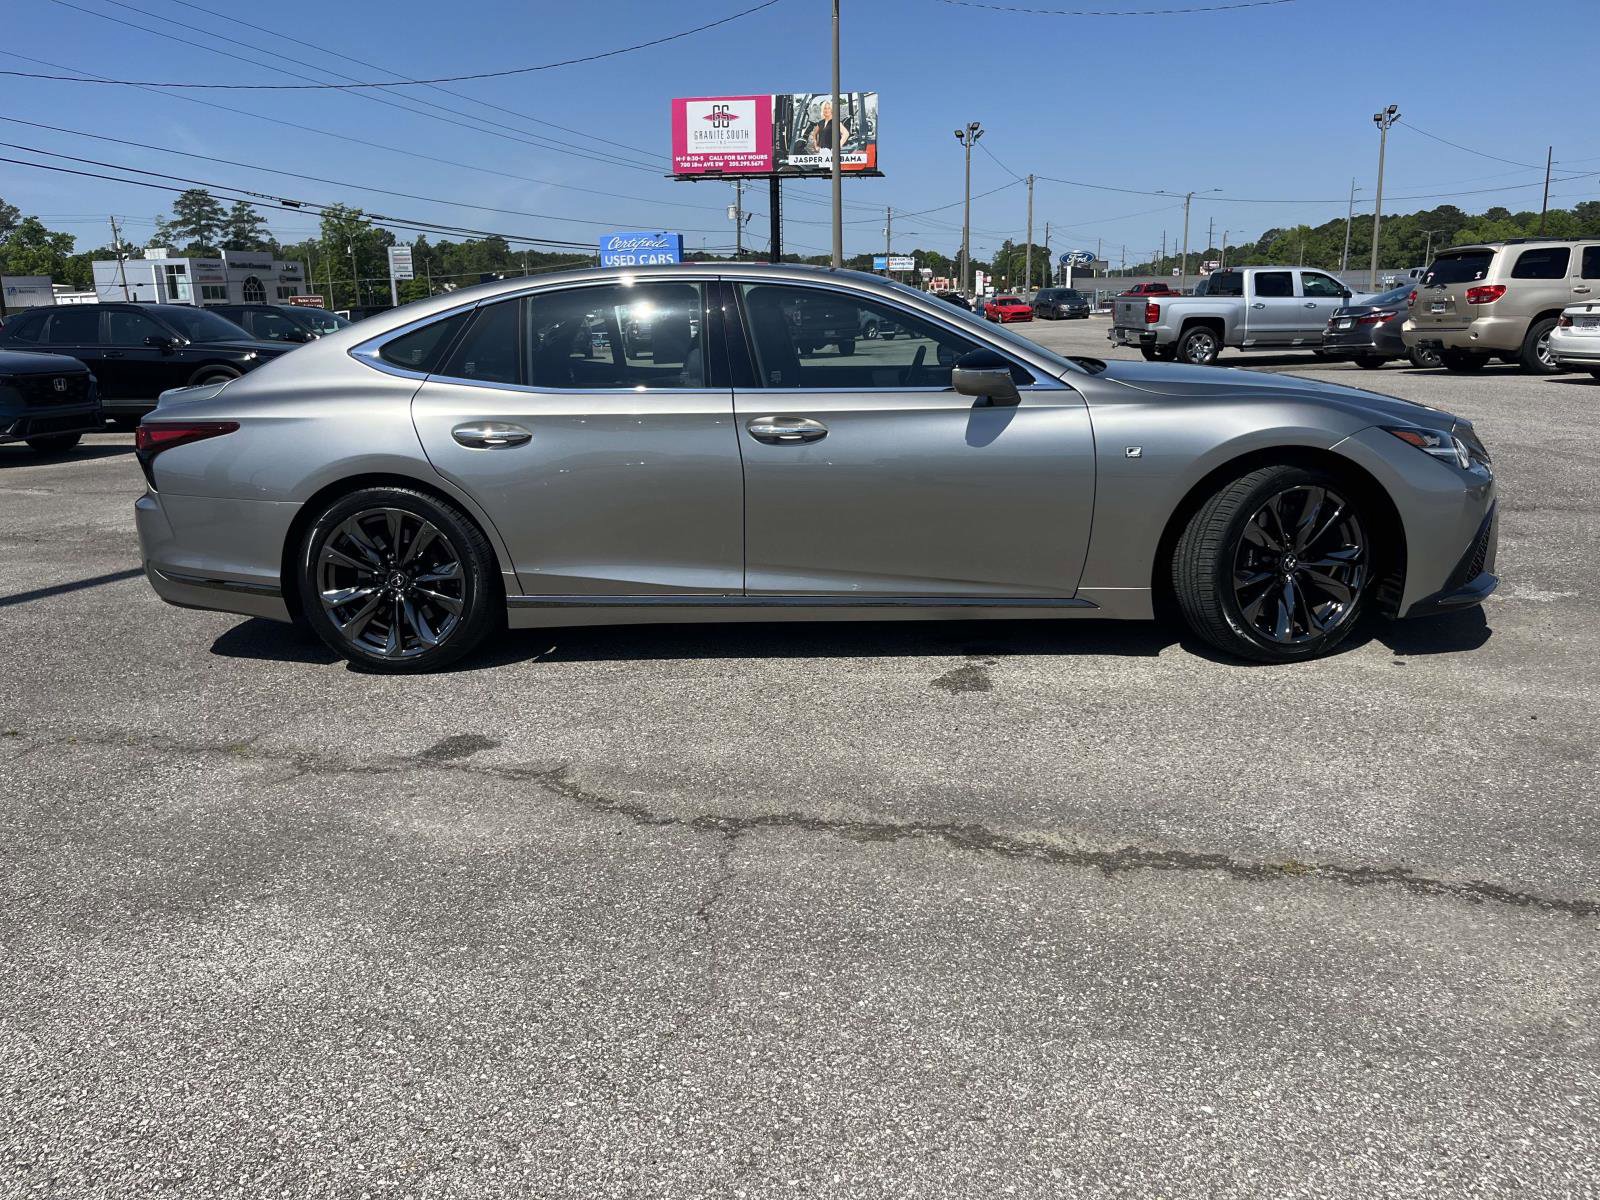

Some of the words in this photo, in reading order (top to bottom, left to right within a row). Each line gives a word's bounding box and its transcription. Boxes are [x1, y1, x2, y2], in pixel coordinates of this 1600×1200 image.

[694, 130, 724, 140] GRANITE
[726, 129, 749, 139] SOUTH
[608, 236, 669, 252] Certified
[605, 254, 636, 266] USED
[638, 254, 674, 265] CARS
